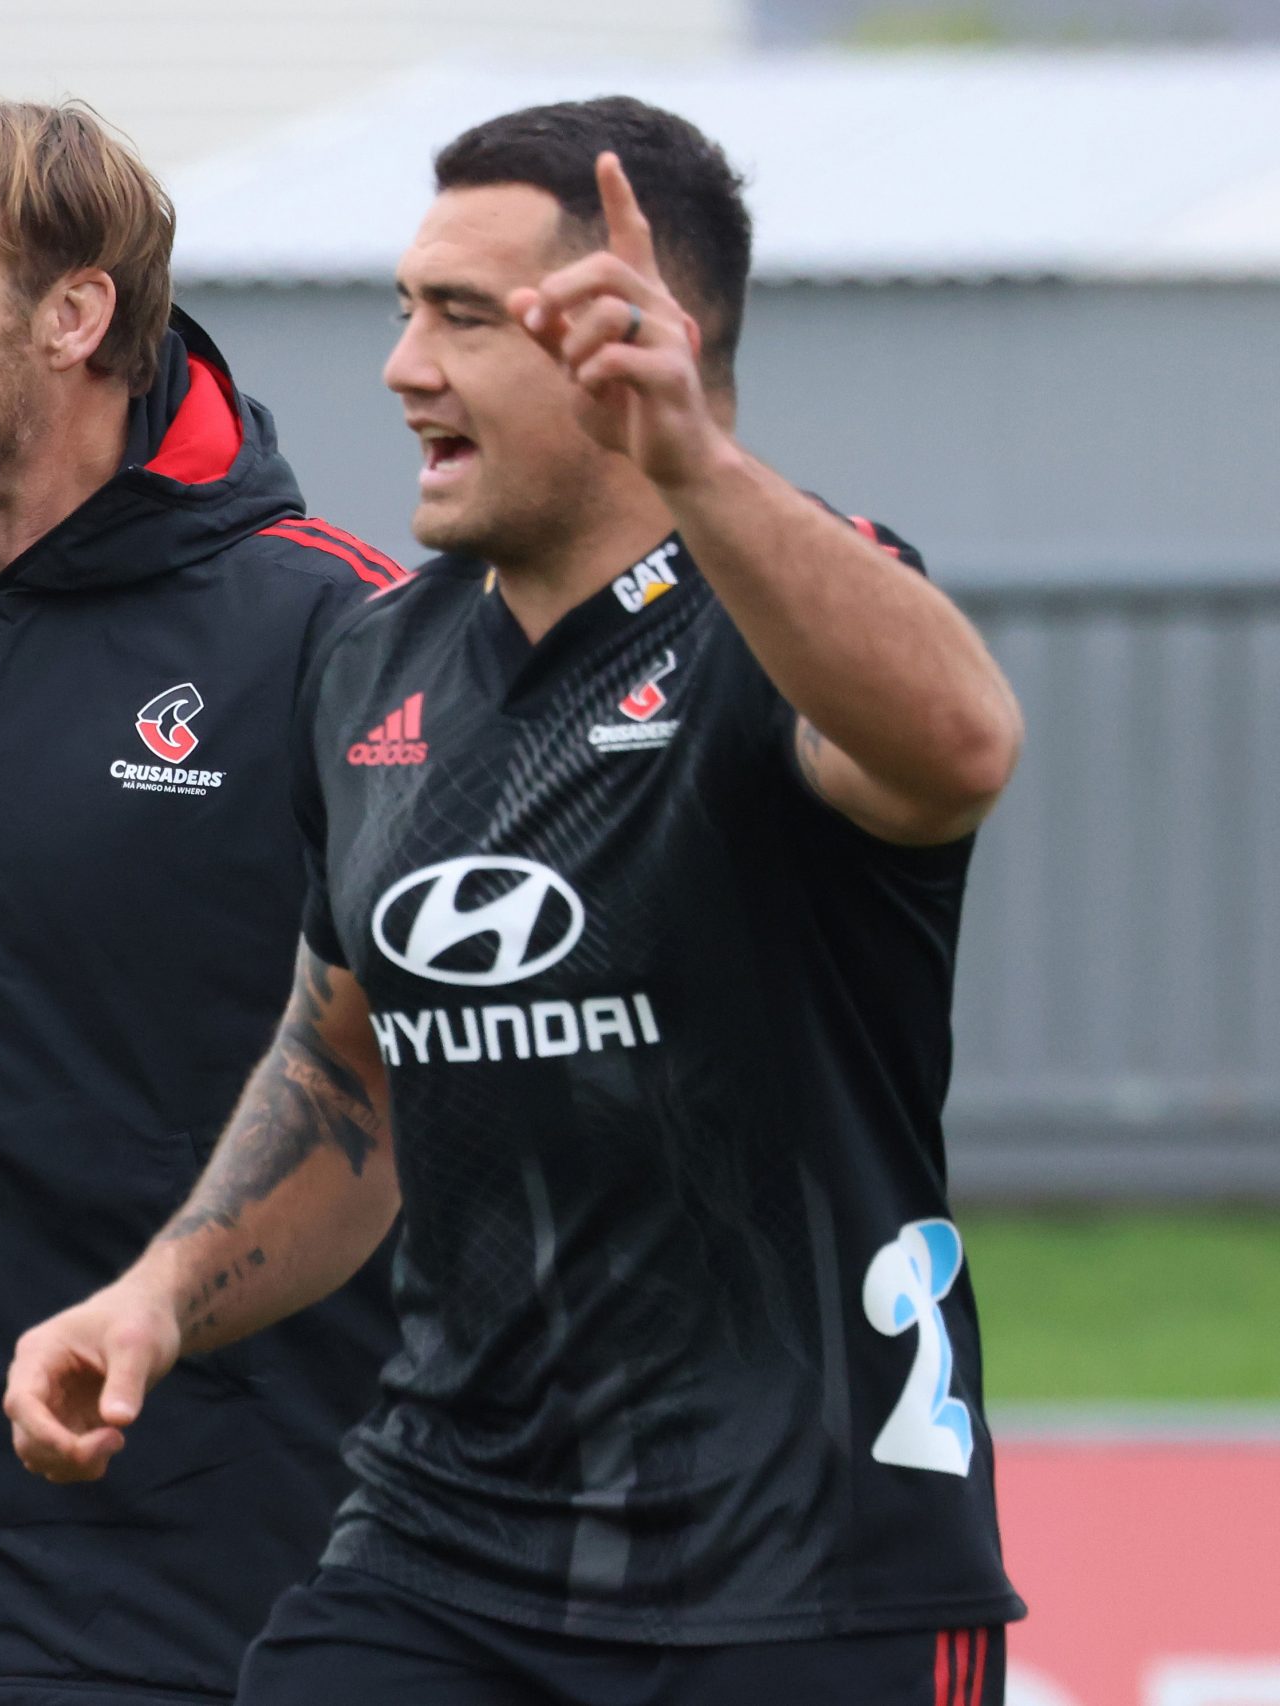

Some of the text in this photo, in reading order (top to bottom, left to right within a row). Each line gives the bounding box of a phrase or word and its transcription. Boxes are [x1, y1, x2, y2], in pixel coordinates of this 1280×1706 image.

[612, 546, 678, 613] CAT
[109, 760, 223, 788] CRUSADERS
[136, 782, 163, 793] PANGO
[177, 786, 207, 796] WHERO
[370, 993, 660, 1066] HYUNDAI
